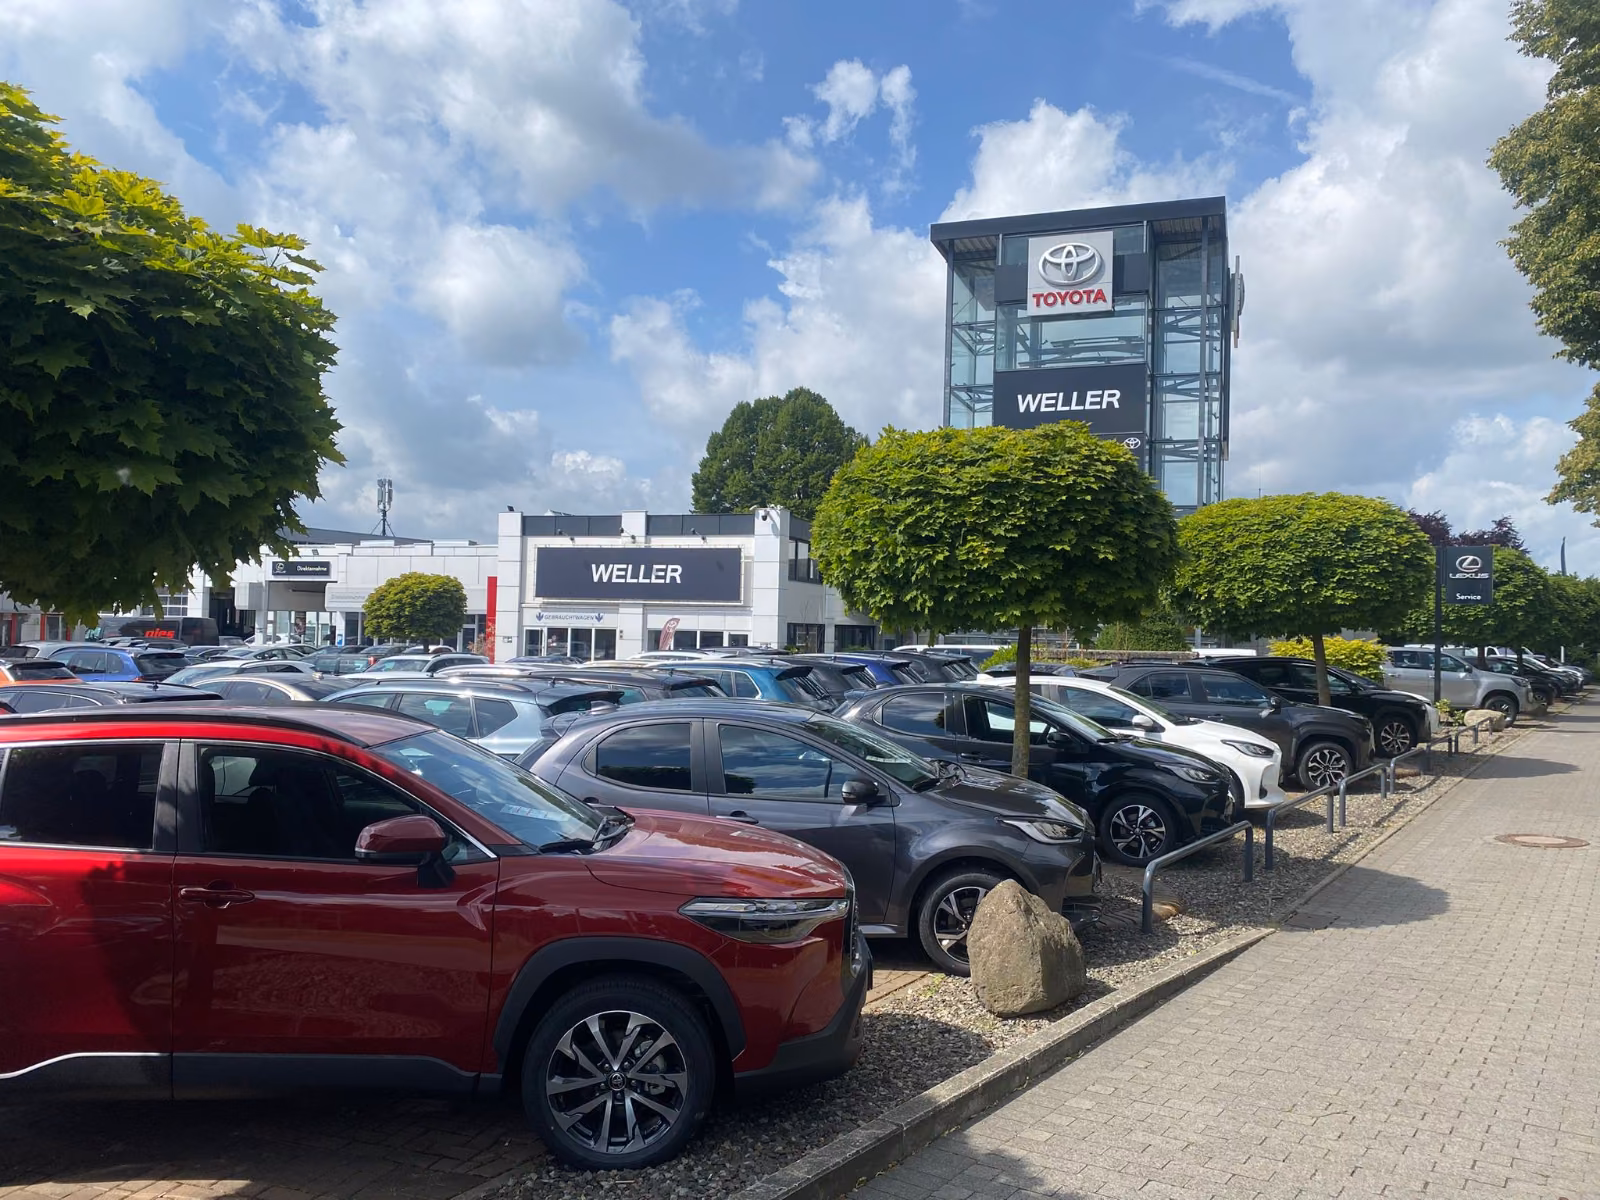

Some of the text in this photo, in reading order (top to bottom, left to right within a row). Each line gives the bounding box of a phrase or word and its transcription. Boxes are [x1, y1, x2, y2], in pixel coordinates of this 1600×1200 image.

[1032, 288, 1107, 308] TOYOTA
[1017, 389, 1121, 413] WELLER
[591, 563, 682, 584] WELLER
[1456, 592, 1482, 600] Service
